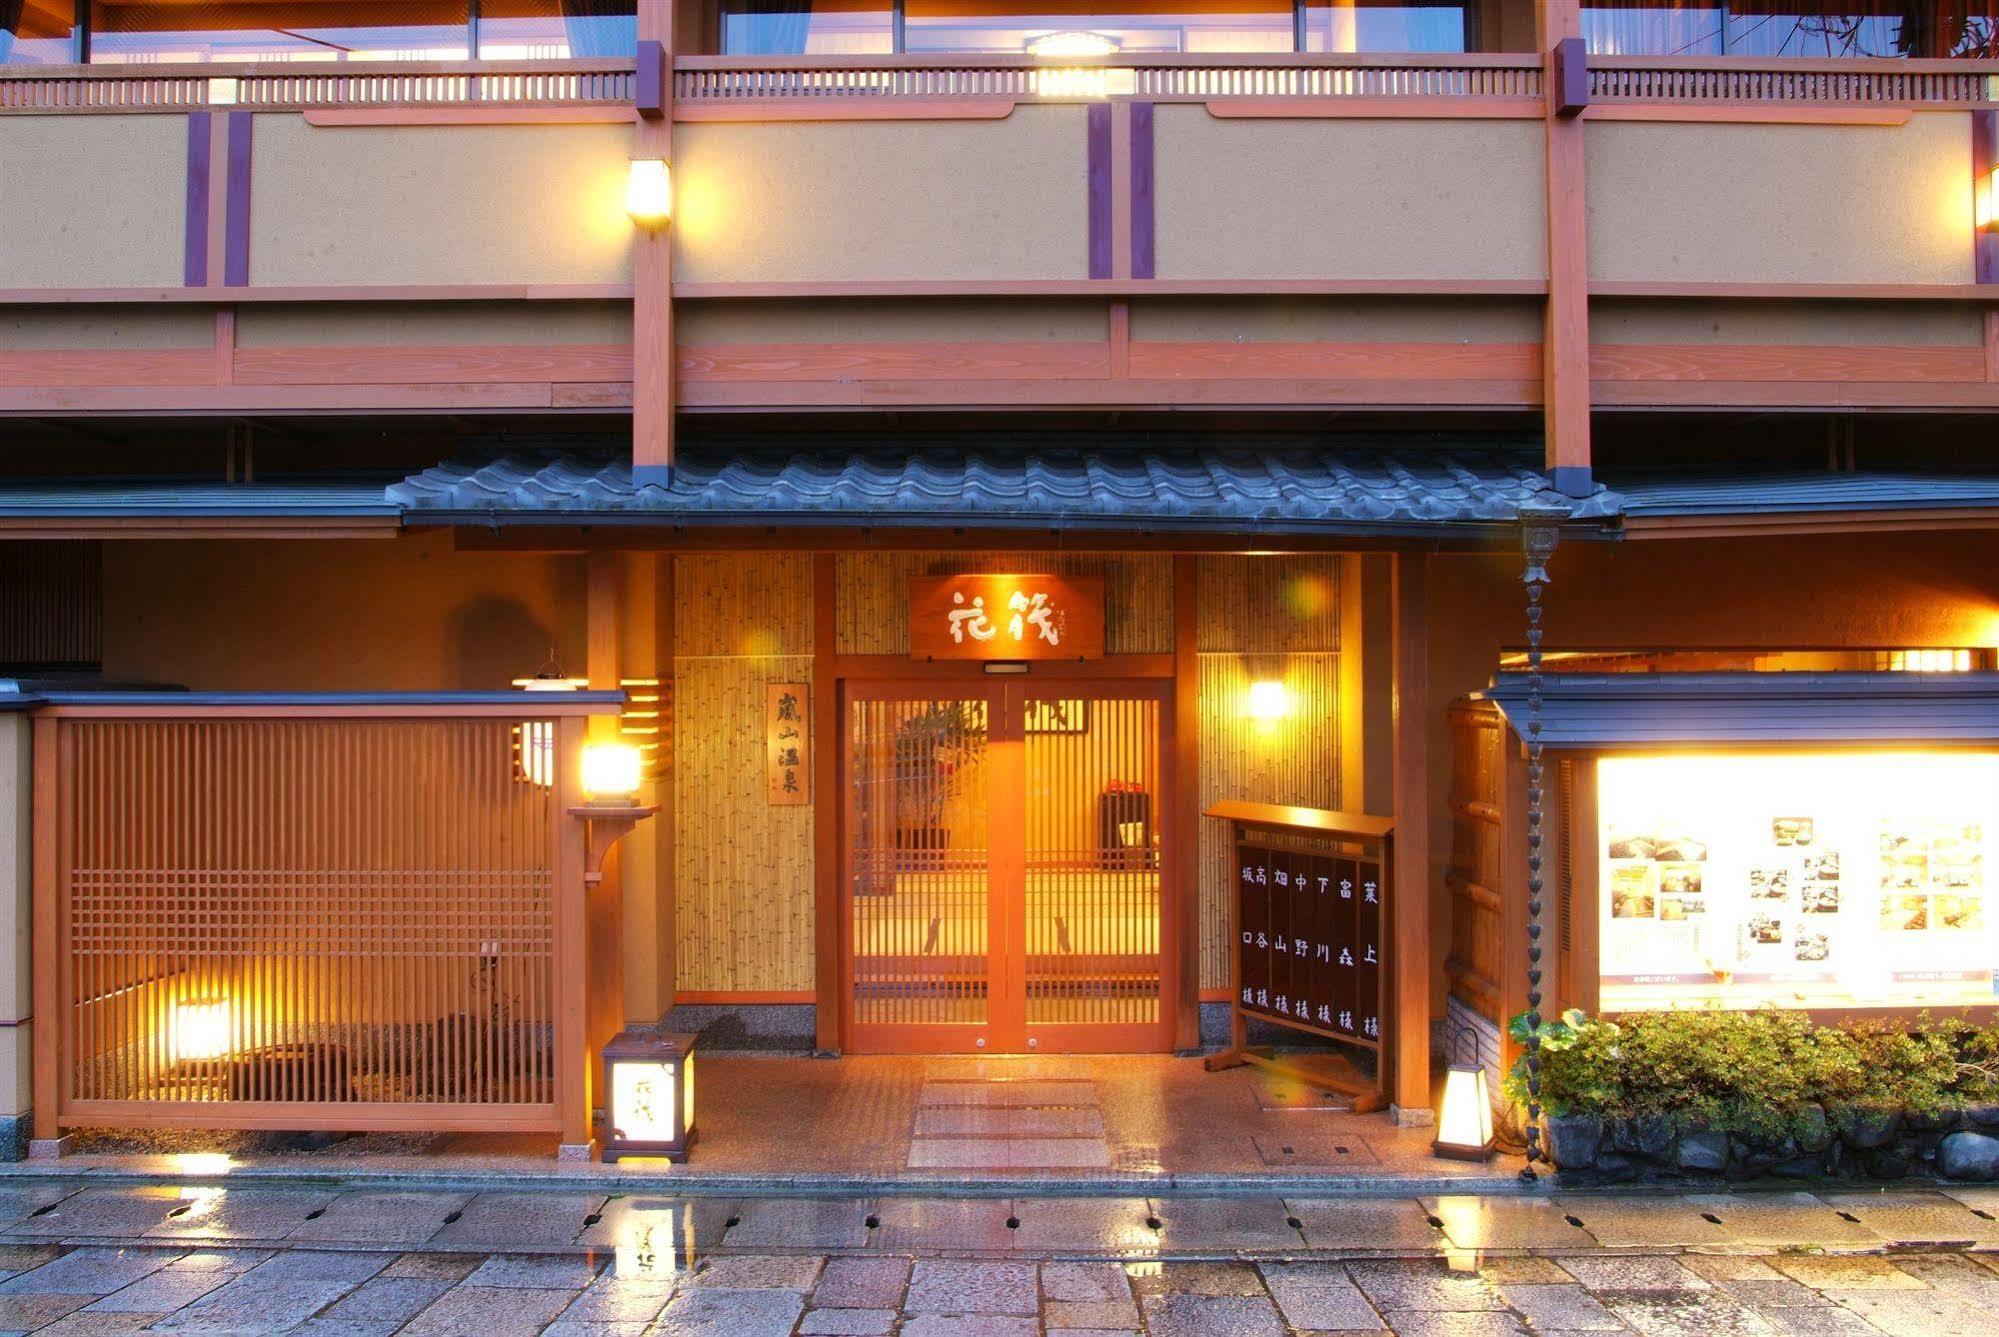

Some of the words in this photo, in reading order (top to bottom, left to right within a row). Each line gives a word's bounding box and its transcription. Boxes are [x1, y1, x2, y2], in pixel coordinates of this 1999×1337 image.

[948, 591, 1062, 646] 花筏
[777, 692, 801, 794] 嵐山温泉
[1256, 865, 1269, 1008] 高谷様
[1275, 869, 1289, 1015] 畑山様
[1295, 873, 1310, 1020] 中野様
[1317, 877, 1332, 1024] 下川様
[1339, 879, 1354, 1031] 富森様
